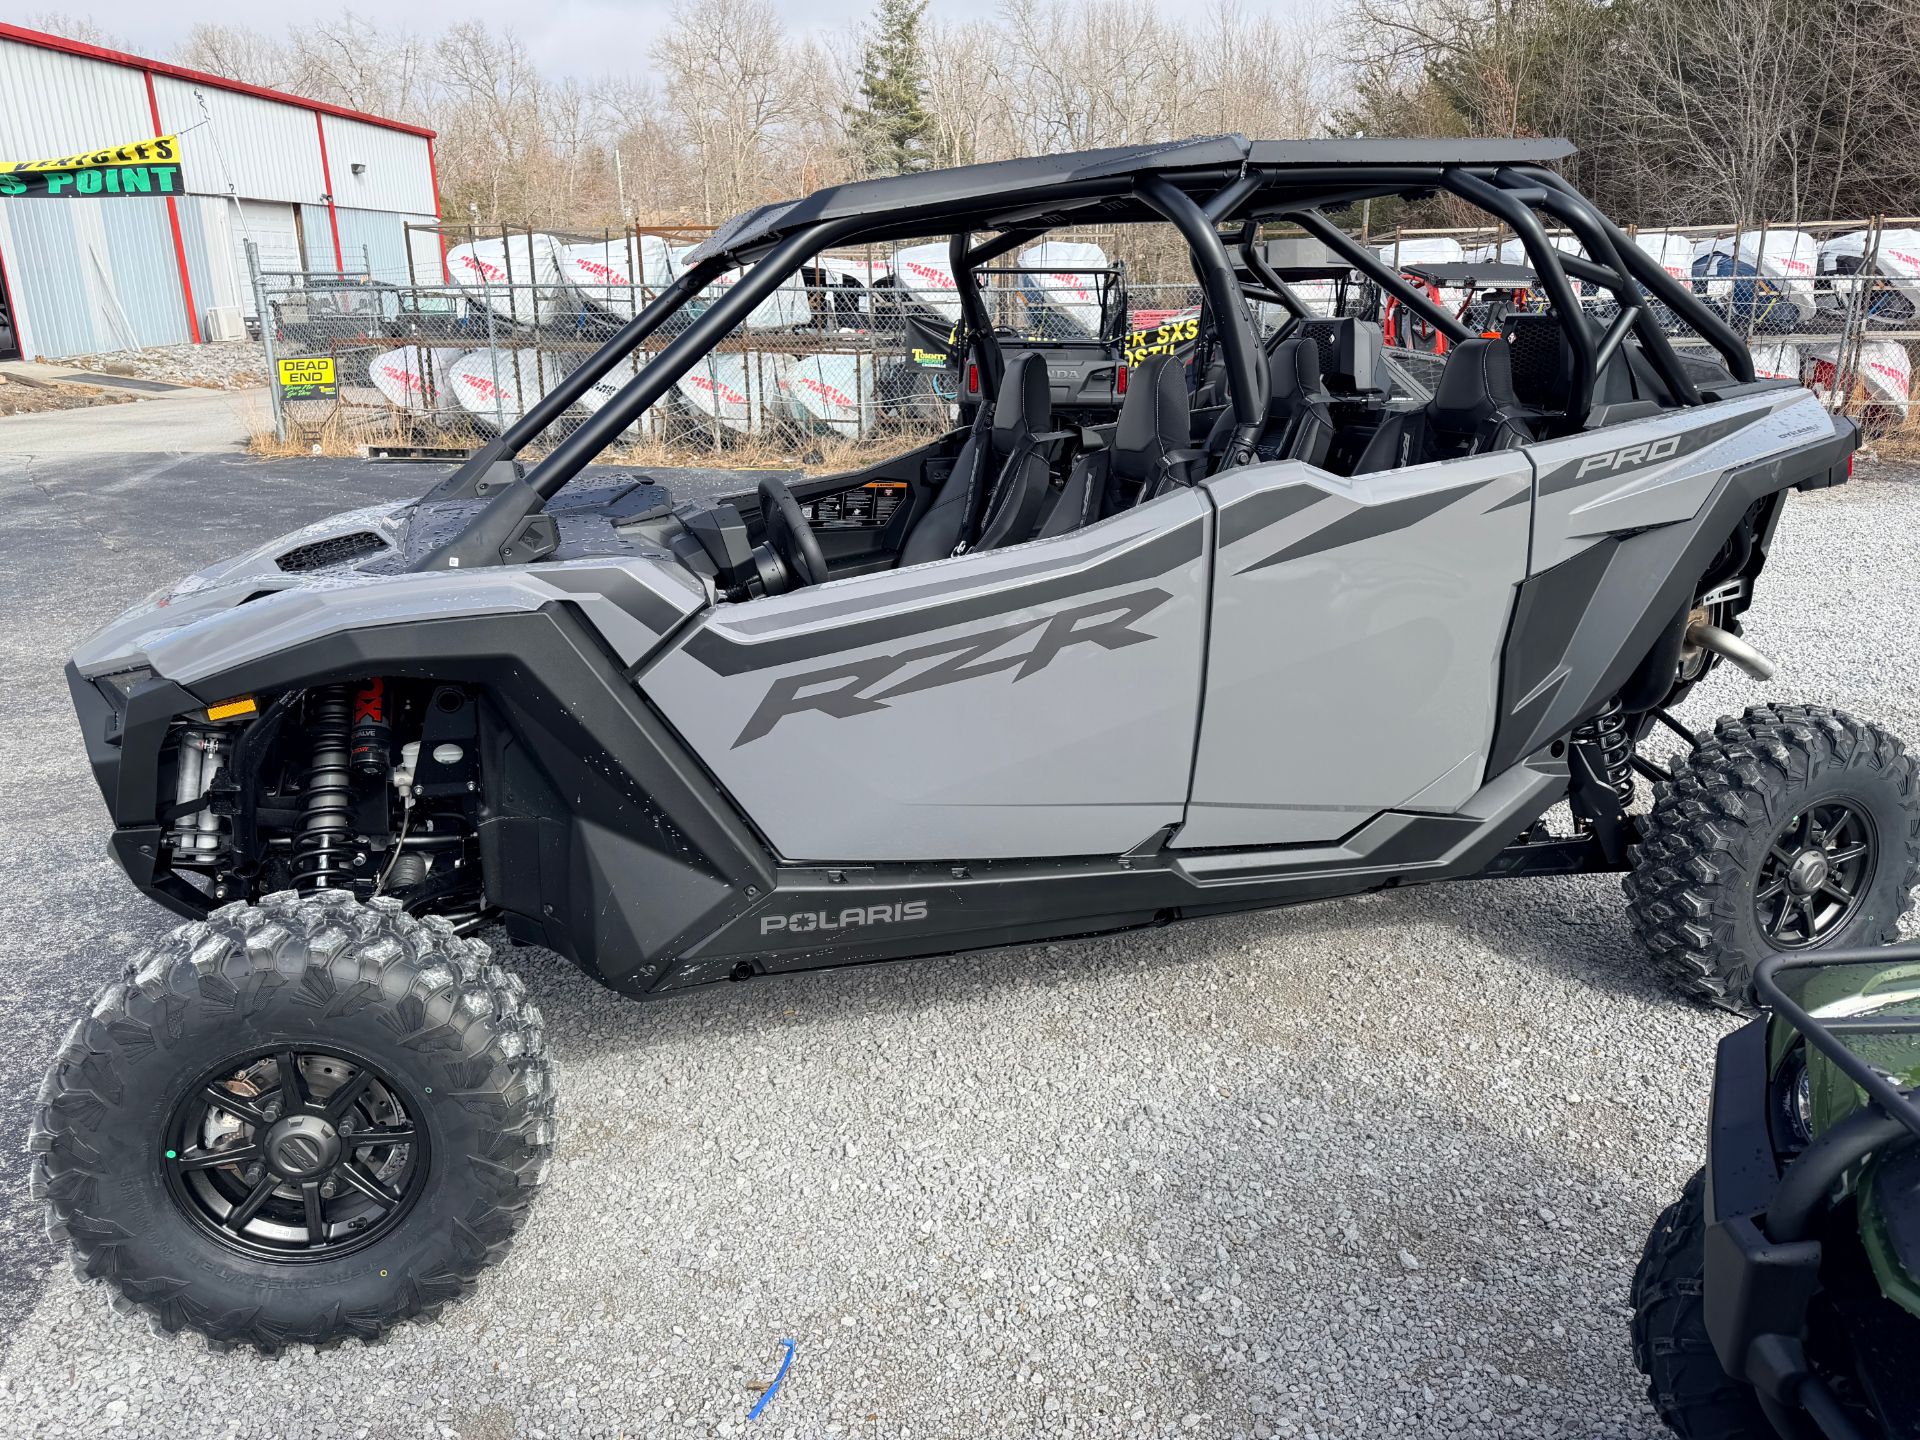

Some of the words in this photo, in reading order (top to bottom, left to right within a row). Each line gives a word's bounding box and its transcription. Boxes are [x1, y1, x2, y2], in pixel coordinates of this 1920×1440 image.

[43, 167, 177, 194] POINT
[1156, 319, 1198, 345] SXS
[284, 360, 329, 371] DEAD
[290, 372, 323, 382] END
[1575, 435, 1682, 480] PRO
[729, 587, 1175, 751] RZR
[760, 900, 928, 935] POLARIS
